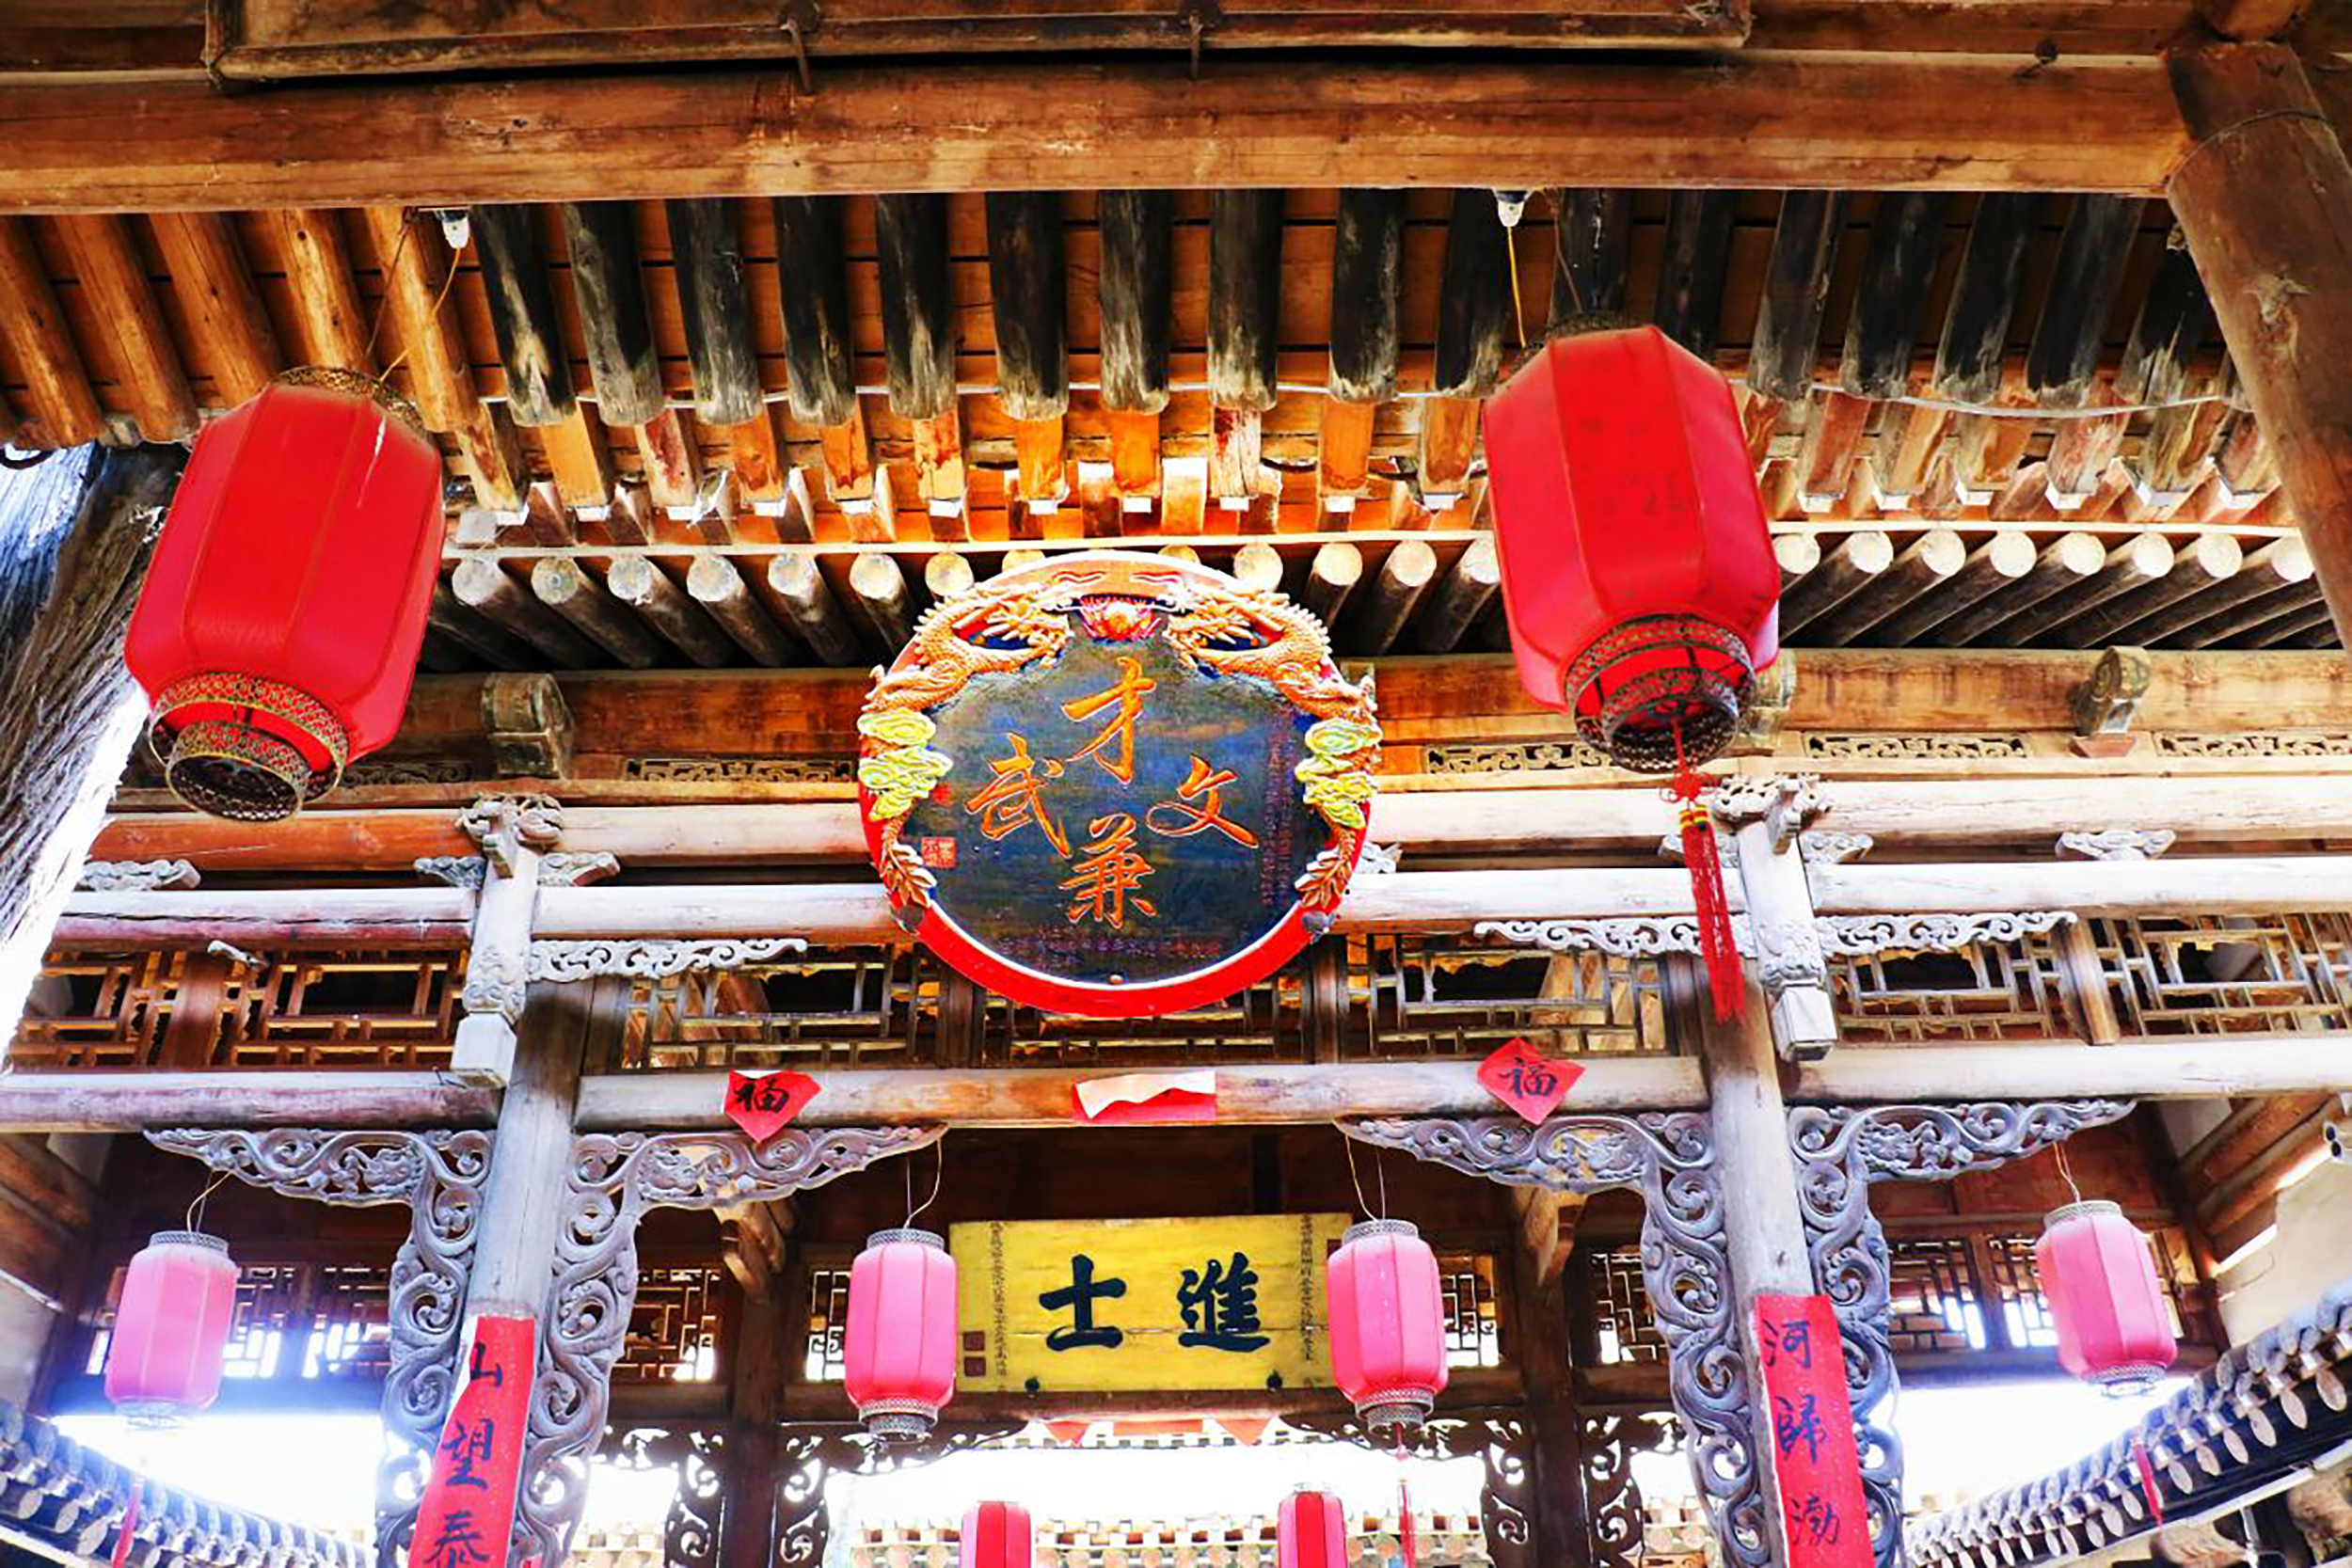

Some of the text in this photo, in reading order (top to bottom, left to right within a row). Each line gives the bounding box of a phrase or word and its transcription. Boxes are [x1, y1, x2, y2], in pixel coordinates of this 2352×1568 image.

[1060, 656, 1156, 784] 才
[964, 732, 1071, 859] 武
[1144, 753, 1259, 849] 文
[1058, 814, 1157, 930] 兼
[733, 1074, 790, 1115] 福
[1498, 1055, 1558, 1099] 福
